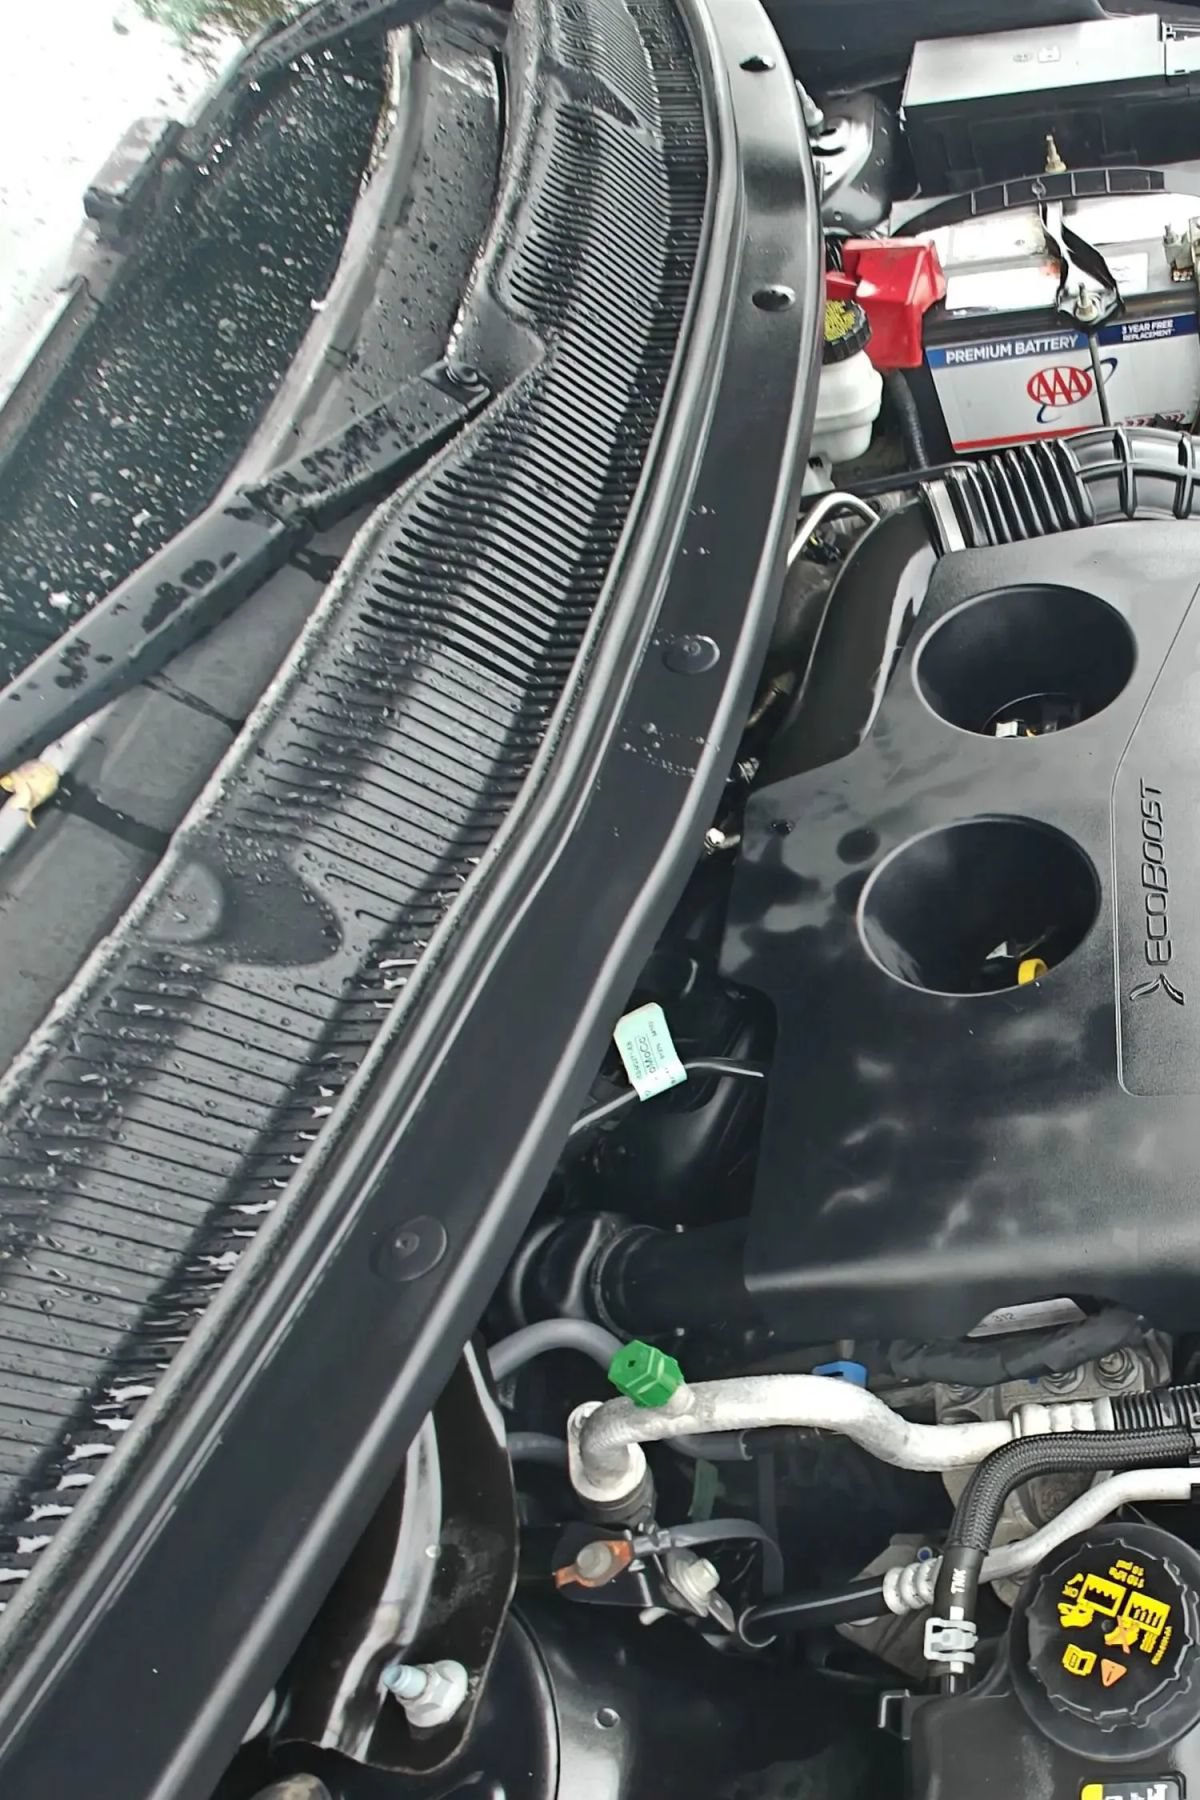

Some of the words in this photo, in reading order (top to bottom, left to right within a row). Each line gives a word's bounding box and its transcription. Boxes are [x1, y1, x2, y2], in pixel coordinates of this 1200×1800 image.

[1128, 322, 1150, 333] YEAR
[1152, 319, 1174, 330] FREE
[945, 342, 1012, 364] PREMIUM
[1015, 335, 1079, 355] BATTERY
[1029, 367, 1092, 406] AAA
